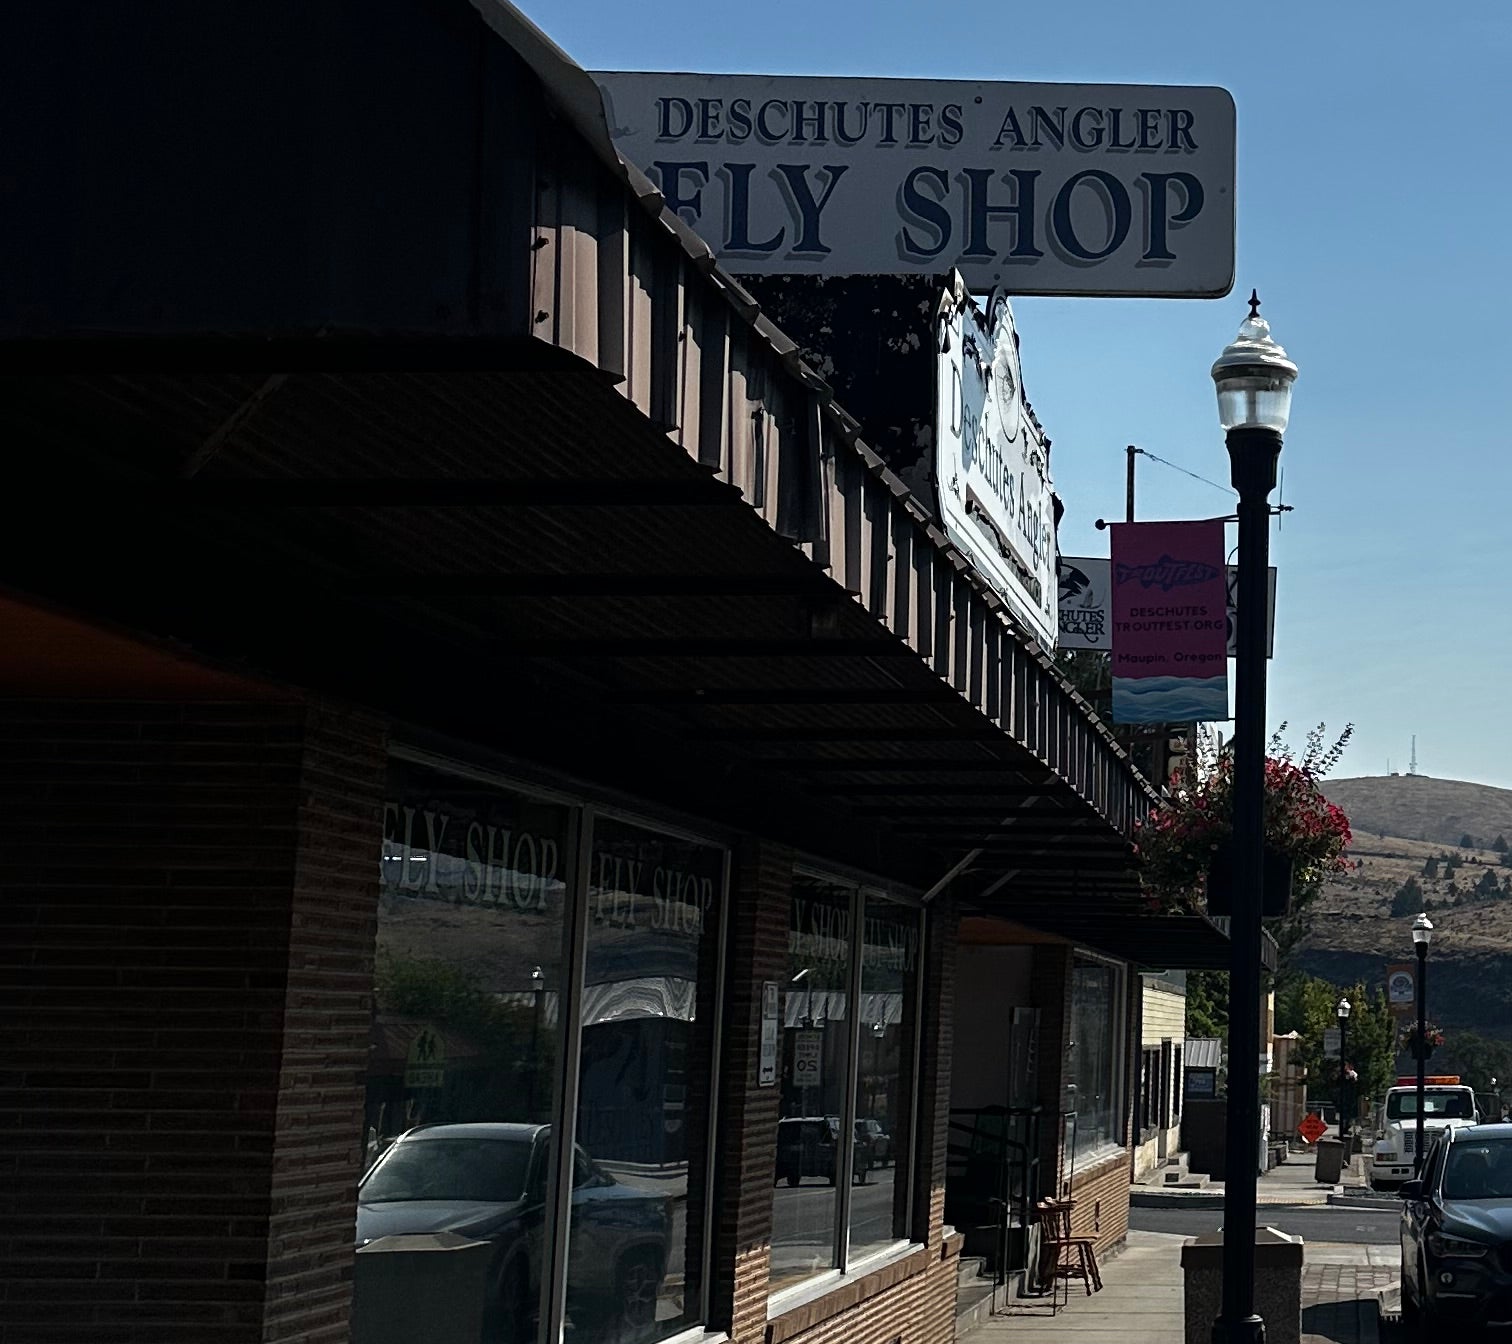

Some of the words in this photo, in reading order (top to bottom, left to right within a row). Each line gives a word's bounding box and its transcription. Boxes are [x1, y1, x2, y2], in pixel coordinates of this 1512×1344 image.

[656, 97, 964, 146] DESCHUTES
[995, 105, 1198, 152] ANGLER
[652, 160, 848, 253] FLY
[901, 166, 1204, 260] SHOP
[950, 356, 1015, 520] Deschutes
[1018, 471, 1051, 573] Angler
[1130, 606, 1208, 617] DESCHUTES
[1174, 652, 1222, 663] Oregon
[464, 820, 559, 911] SHOP
[596, 852, 643, 924] FLY
[652, 865, 713, 936] SHOP
